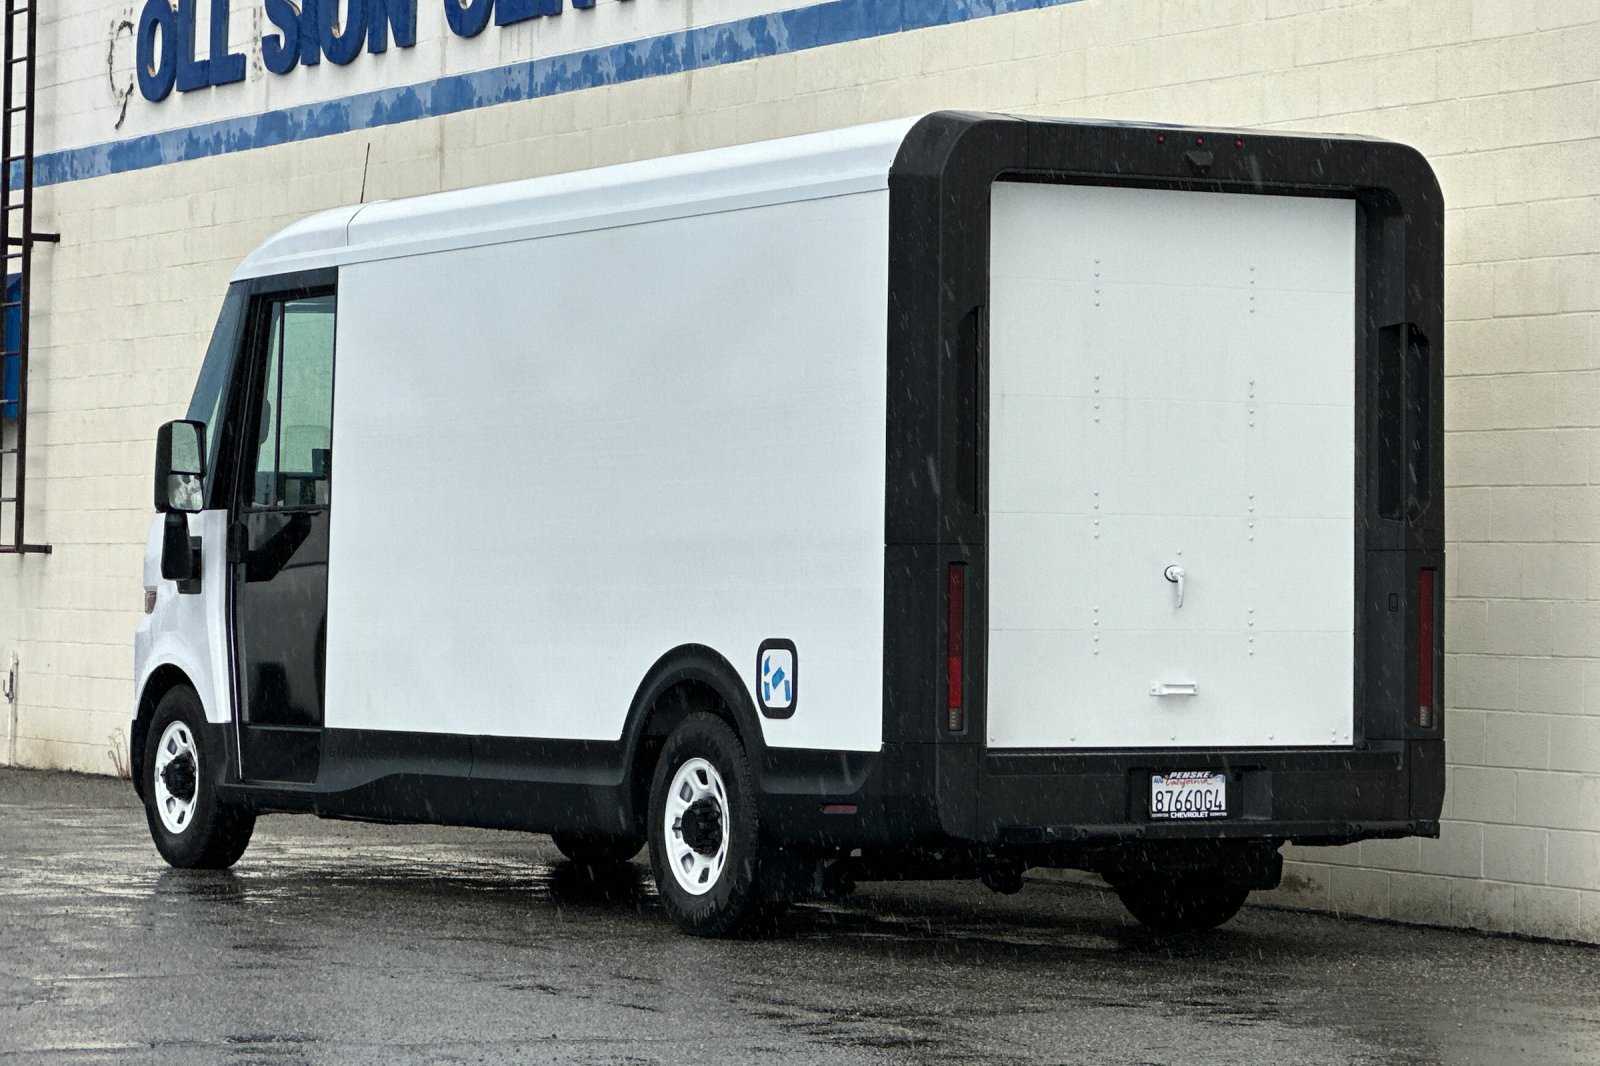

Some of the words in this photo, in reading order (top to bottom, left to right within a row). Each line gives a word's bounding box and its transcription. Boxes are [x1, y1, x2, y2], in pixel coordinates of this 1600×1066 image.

[1169, 771, 1211, 779] PENSKE
[1165, 778, 1212, 789] California
[1155, 789, 1222, 811] 87660G4
